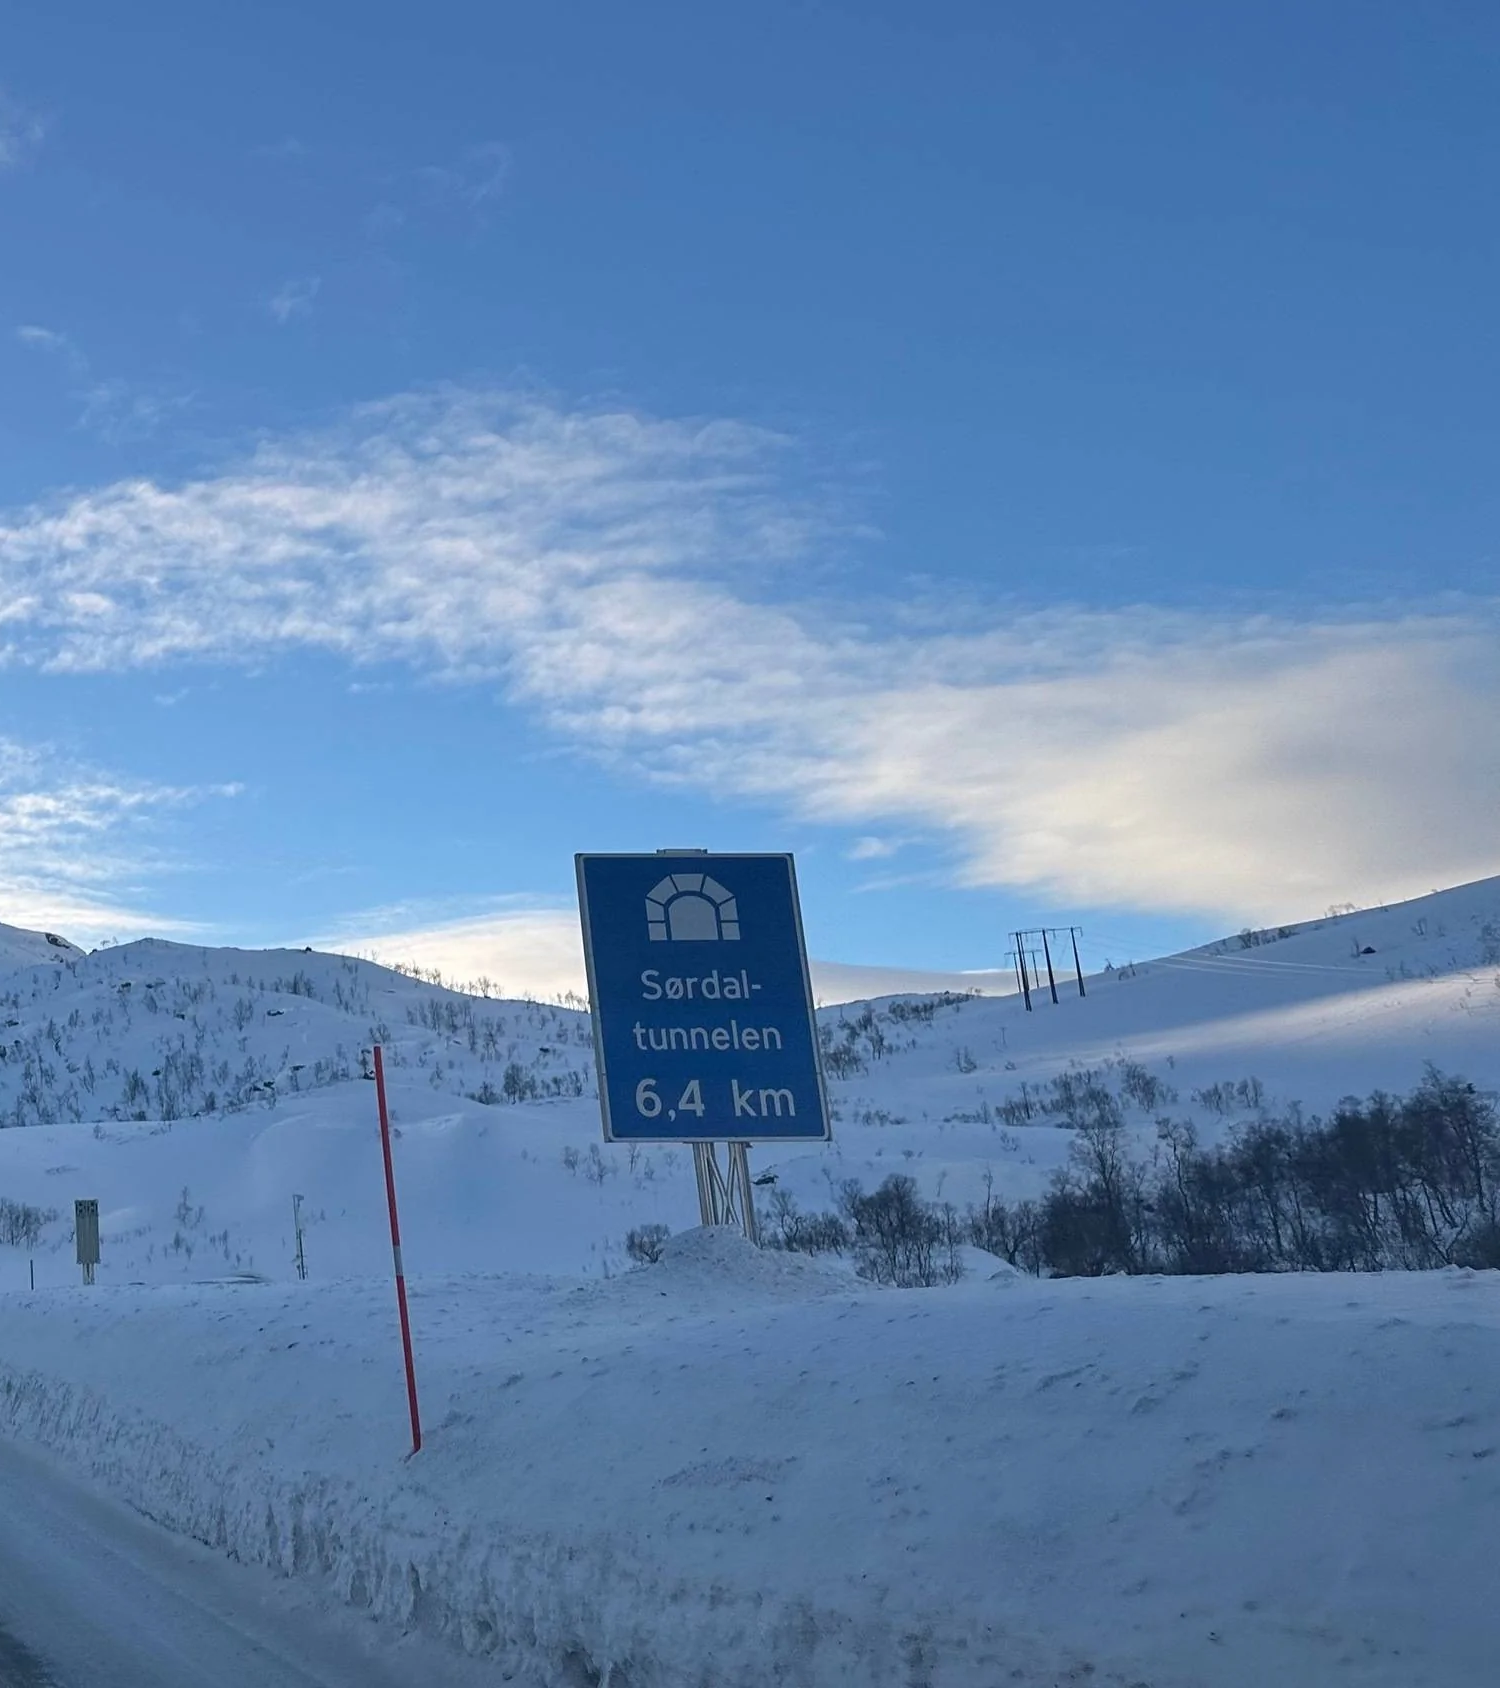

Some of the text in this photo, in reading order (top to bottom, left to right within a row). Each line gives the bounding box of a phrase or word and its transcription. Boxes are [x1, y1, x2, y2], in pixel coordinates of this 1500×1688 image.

[640, 969, 762, 1000] Sørdal-
[632, 1019, 782, 1051] tunnelen
[635, 1078, 796, 1122] 6,4 km
